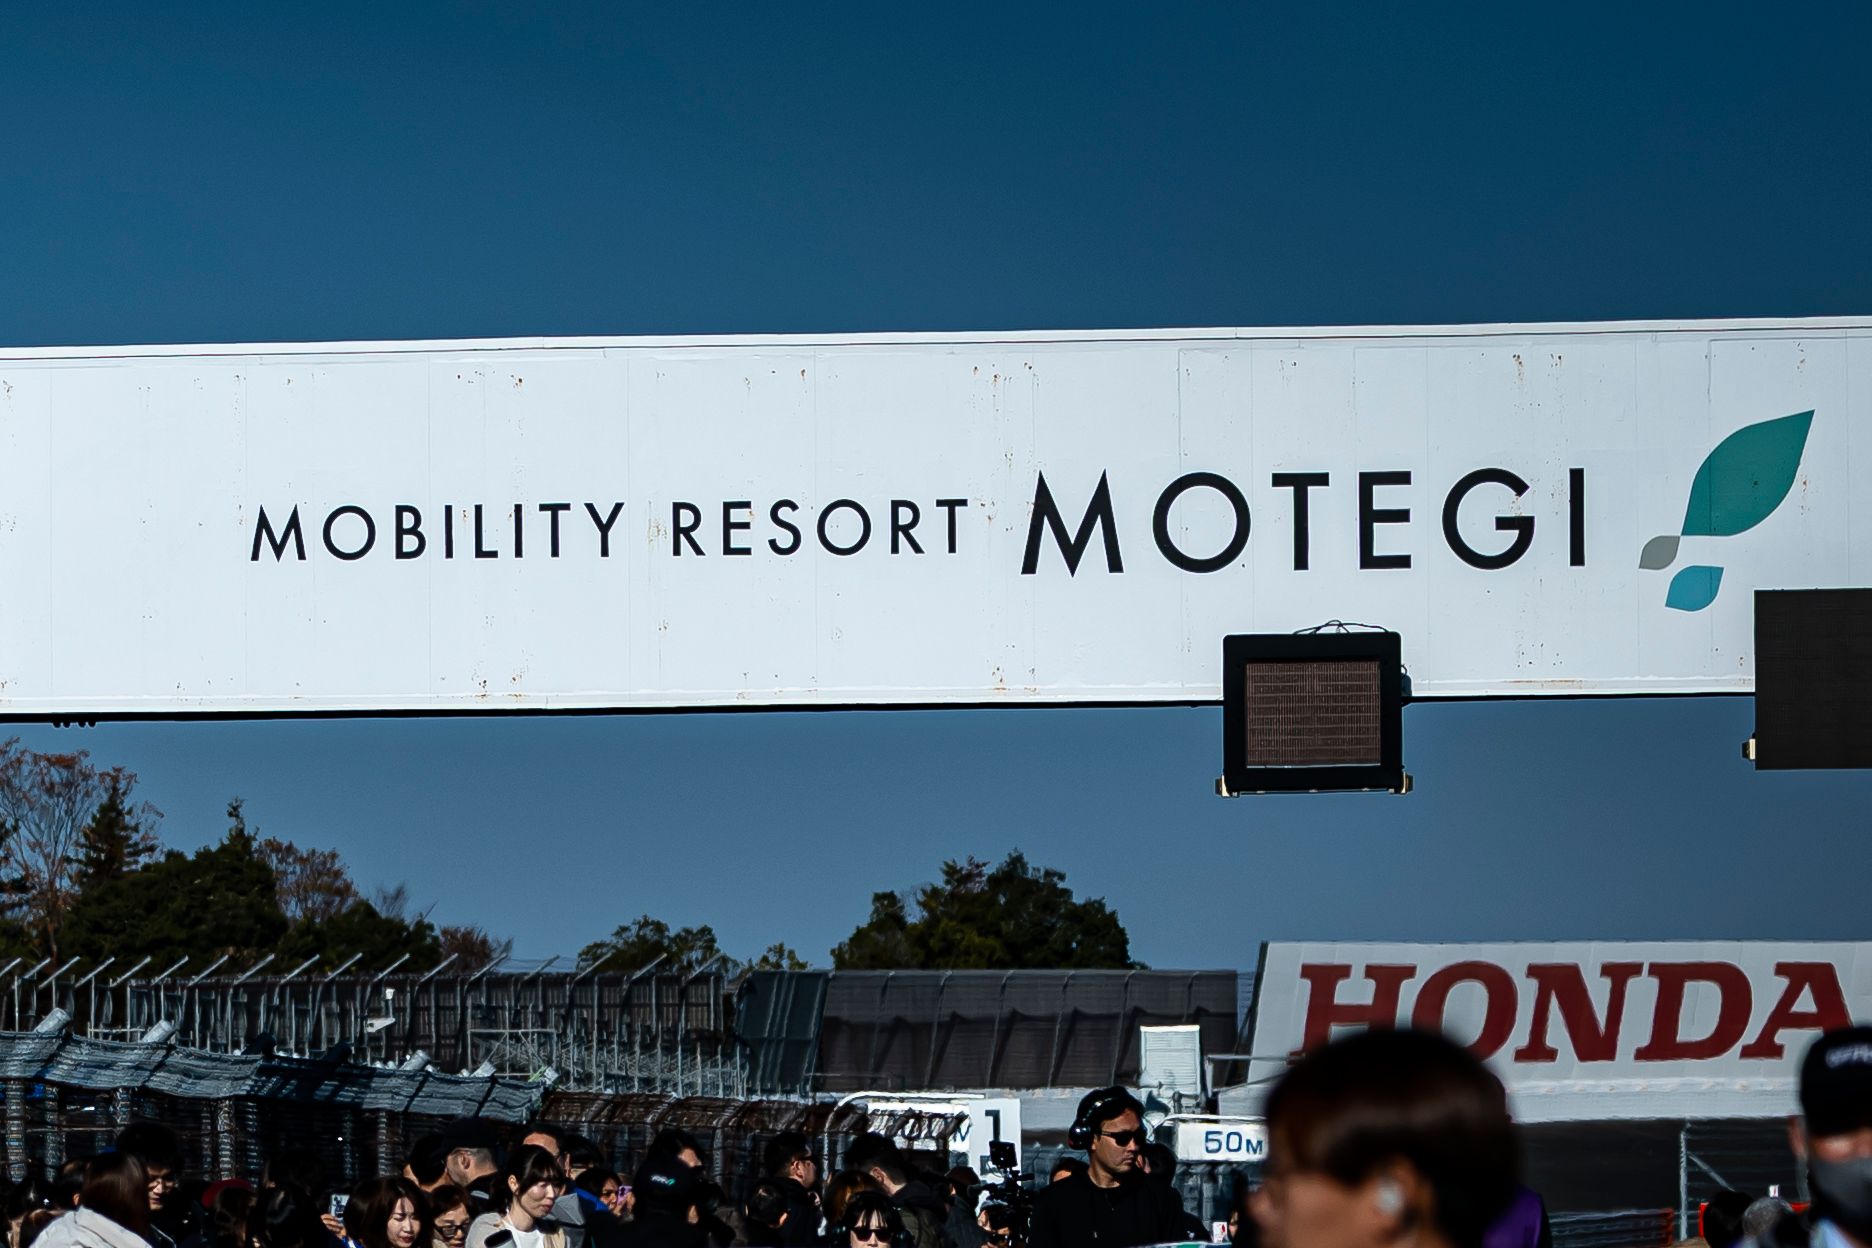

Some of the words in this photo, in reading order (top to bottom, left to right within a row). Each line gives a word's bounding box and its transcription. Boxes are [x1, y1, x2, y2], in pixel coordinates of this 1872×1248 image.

[250, 502, 625, 562] MOBILITY
[672, 498, 968, 557] RESORT
[1020, 467, 1586, 578] MOTEGI
[1288, 960, 1853, 1066] HONDA
[1204, 1130, 1263, 1155] 50M
